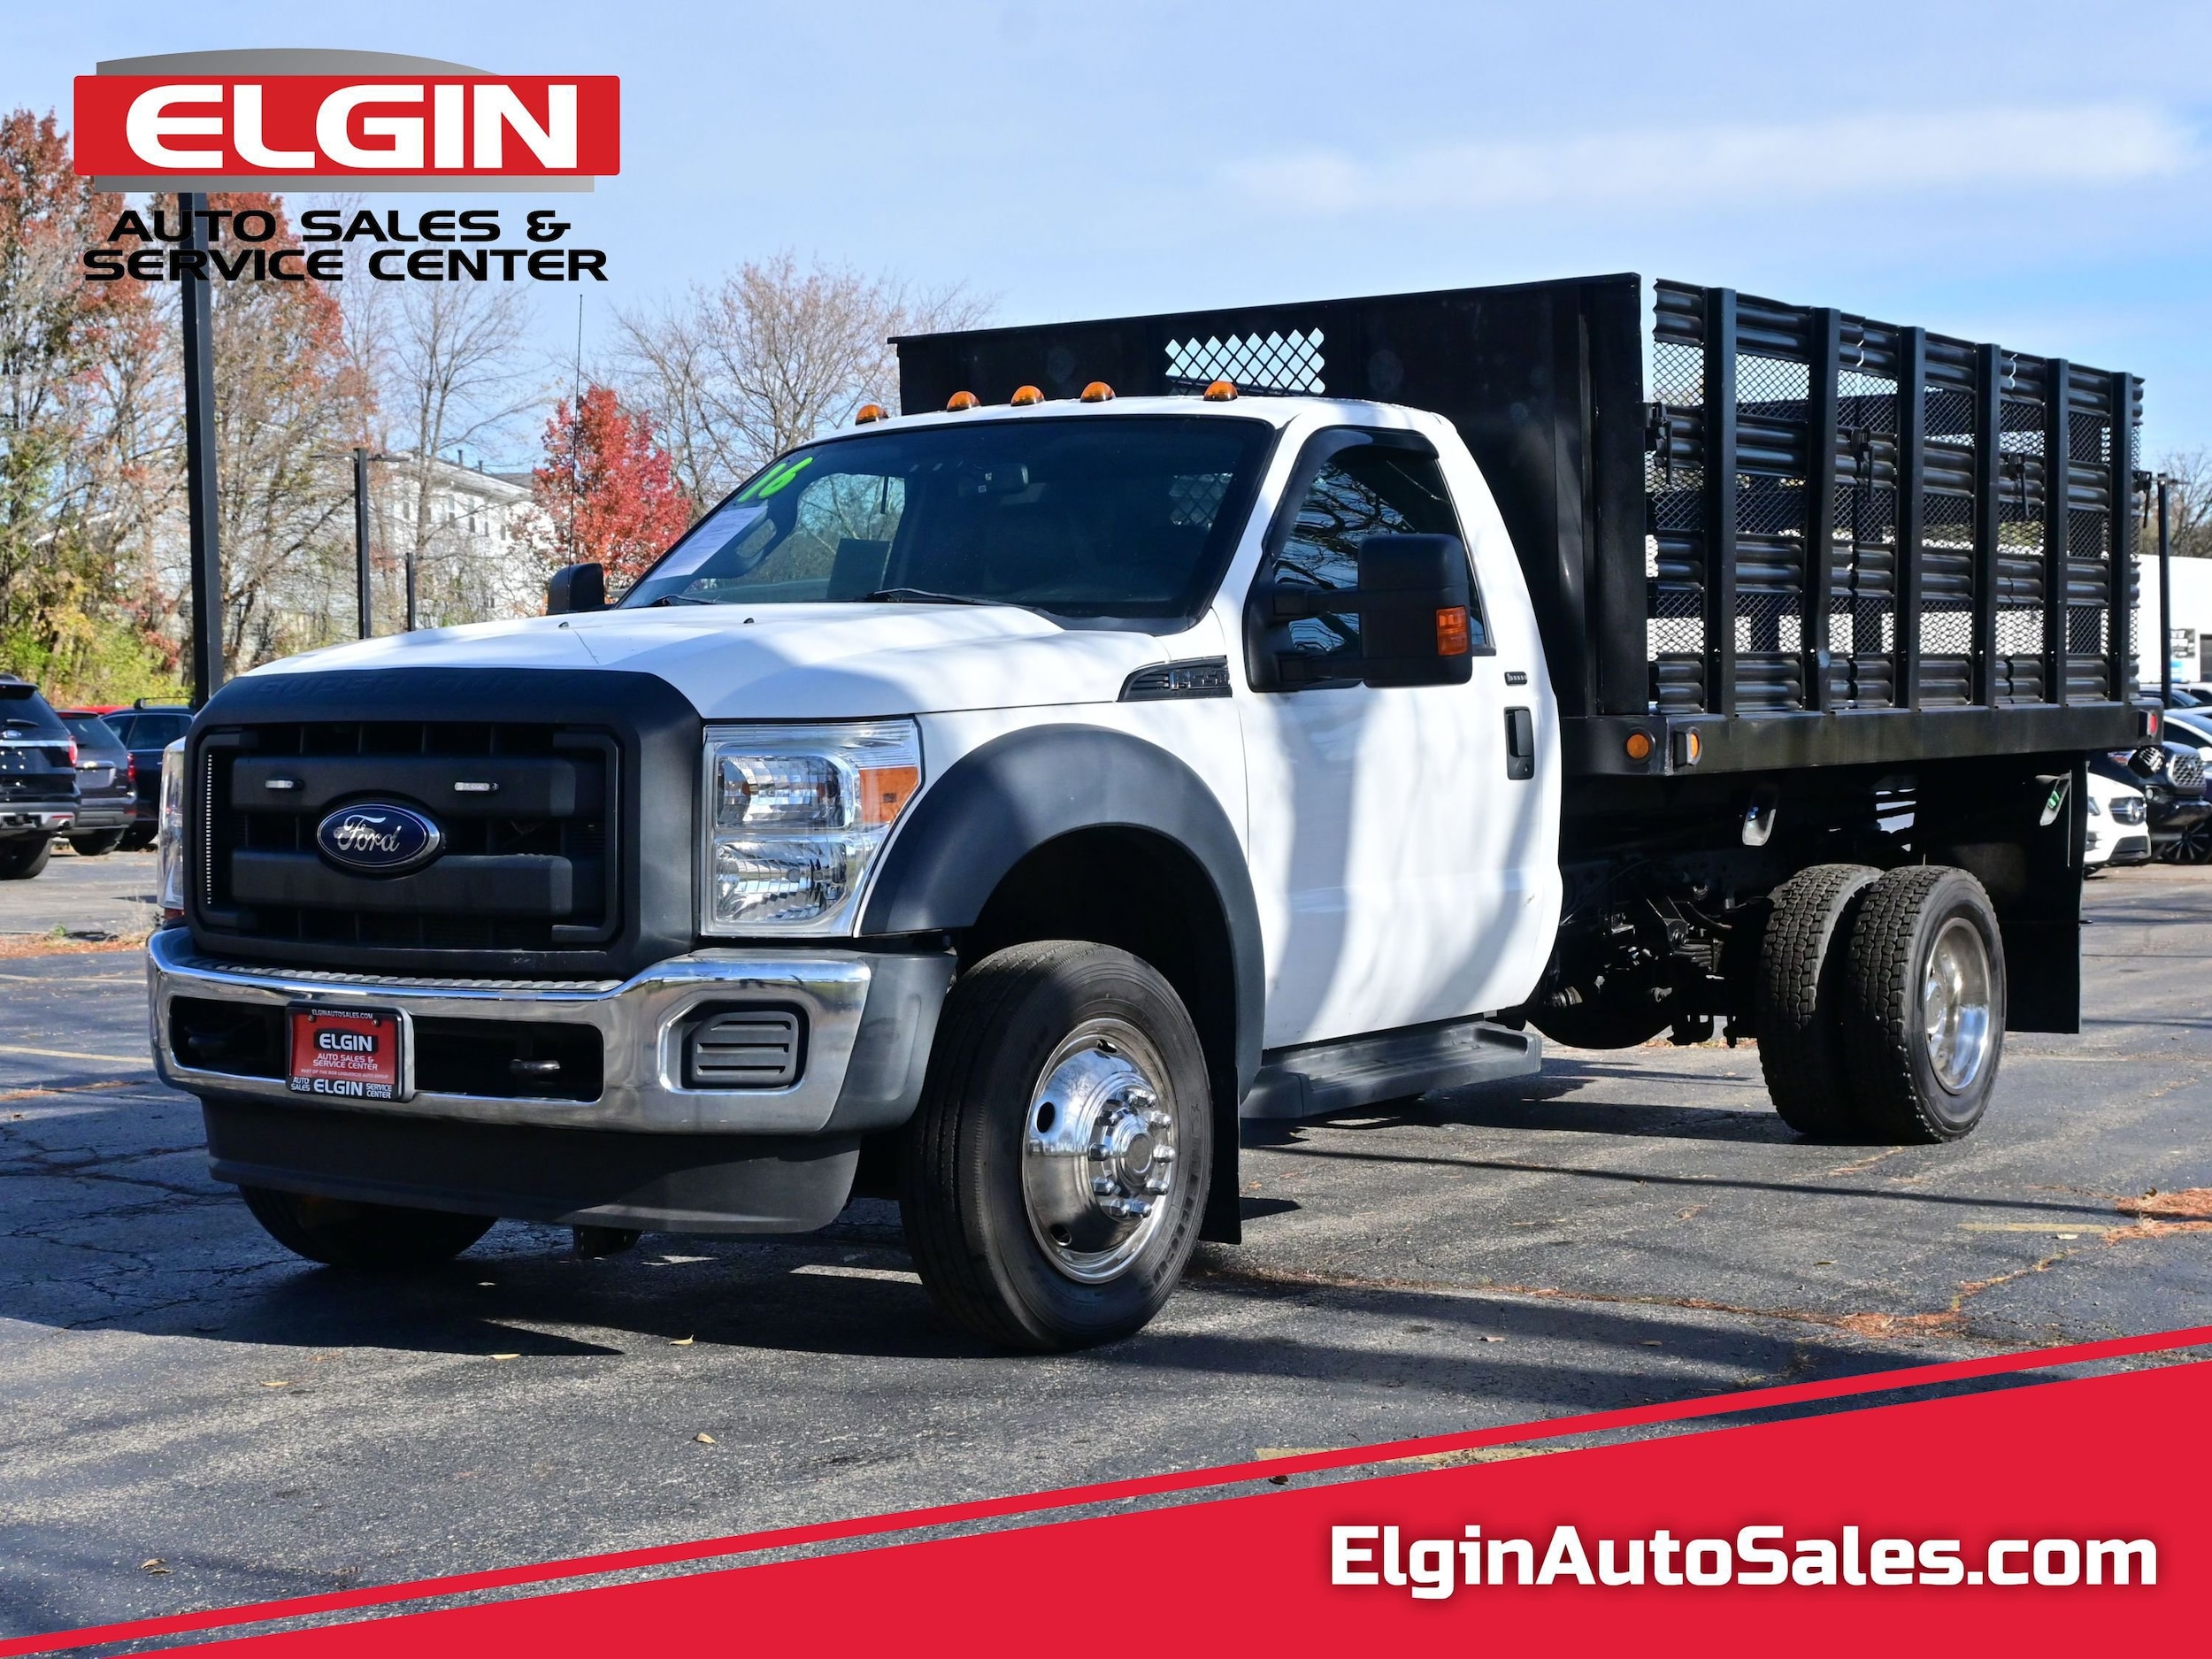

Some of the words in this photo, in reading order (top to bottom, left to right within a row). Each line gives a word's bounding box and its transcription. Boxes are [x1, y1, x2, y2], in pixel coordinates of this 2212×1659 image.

[334, 814, 402, 852] Ford
[311, 1009, 373, 1019] ELGINAUTOSALES.COM
[319, 1033, 373, 1052] ELGIN
[317, 1053, 338, 1062] AUTO
[340, 1054, 365, 1063] SALES
[312, 1059, 346, 1069] SERVICE
[348, 1062, 378, 1071] CENTER
[292, 1076, 310, 1085] AUTO
[290, 1083, 311, 1092] SALES
[313, 1079, 363, 1096] ELGIN
[365, 1082, 392, 1093] SERVICE
[366, 1089, 391, 1099] CENTER
